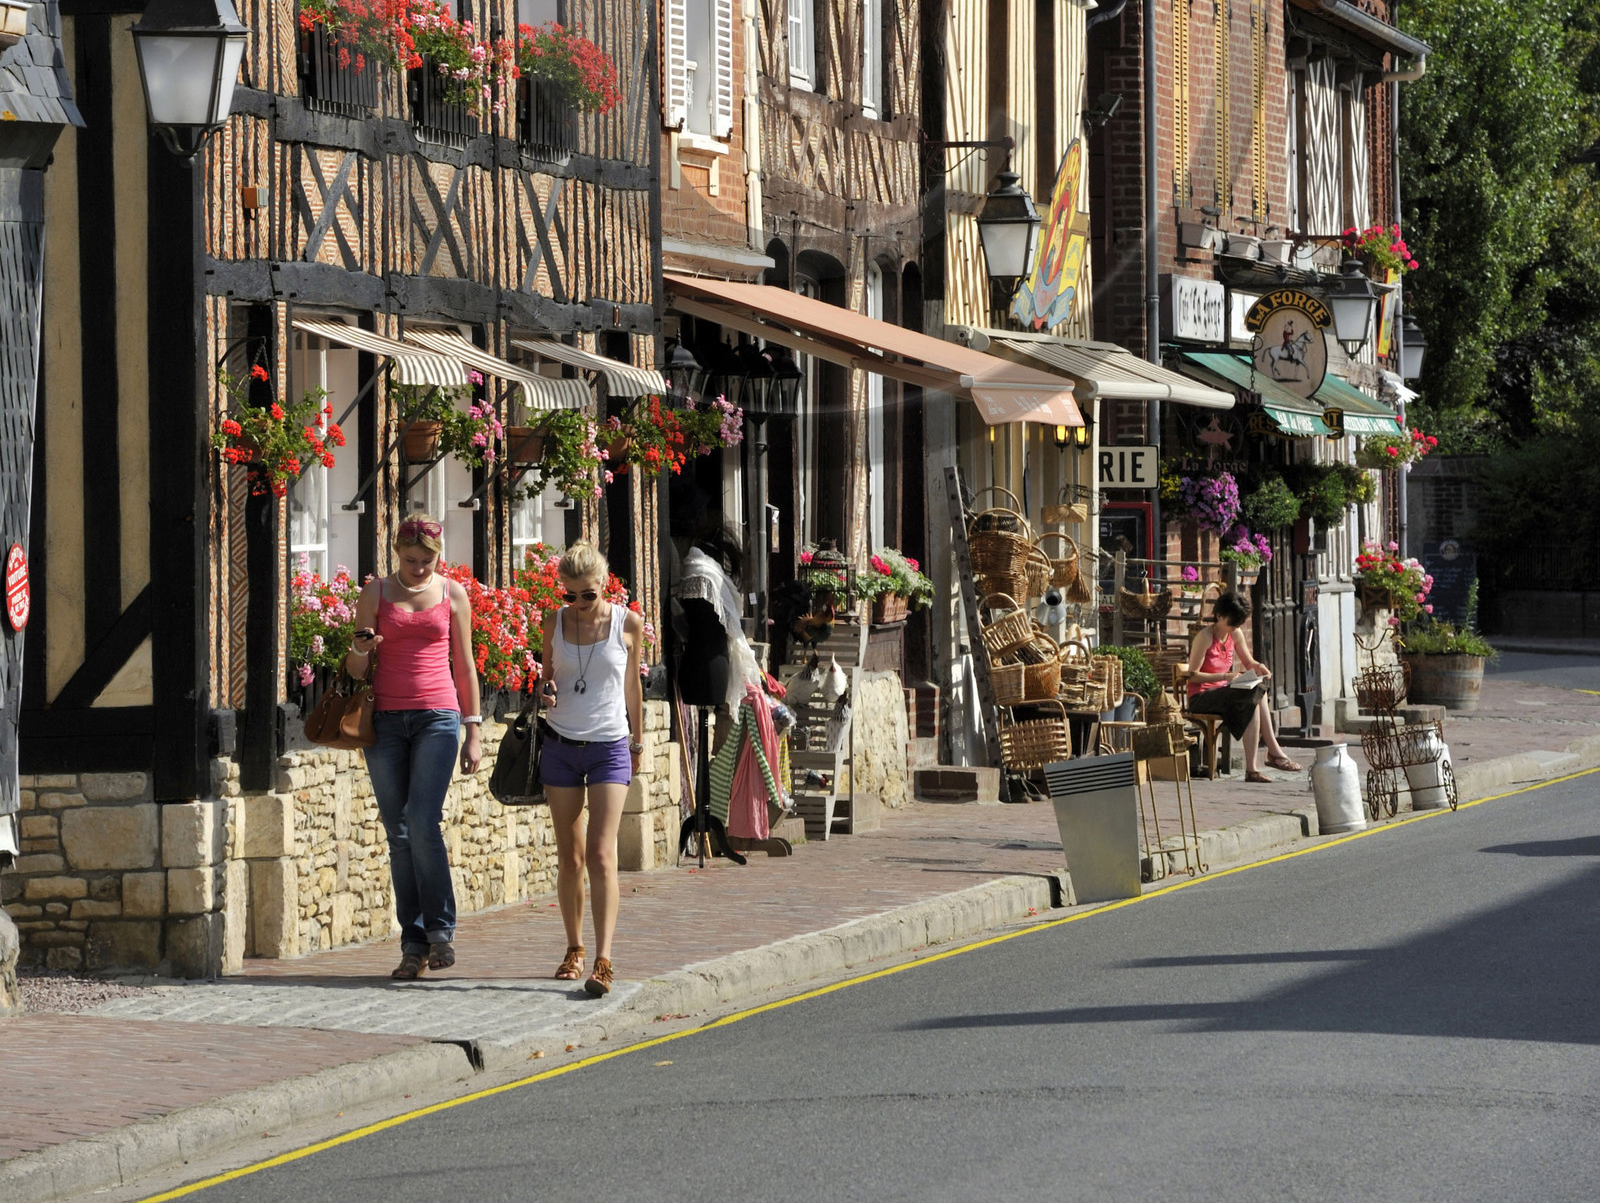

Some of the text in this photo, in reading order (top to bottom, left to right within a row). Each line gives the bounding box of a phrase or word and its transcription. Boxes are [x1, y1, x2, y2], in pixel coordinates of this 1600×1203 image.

[1248, 291, 1327, 325] LA FORGE
[1099, 452, 1145, 483] RIE
